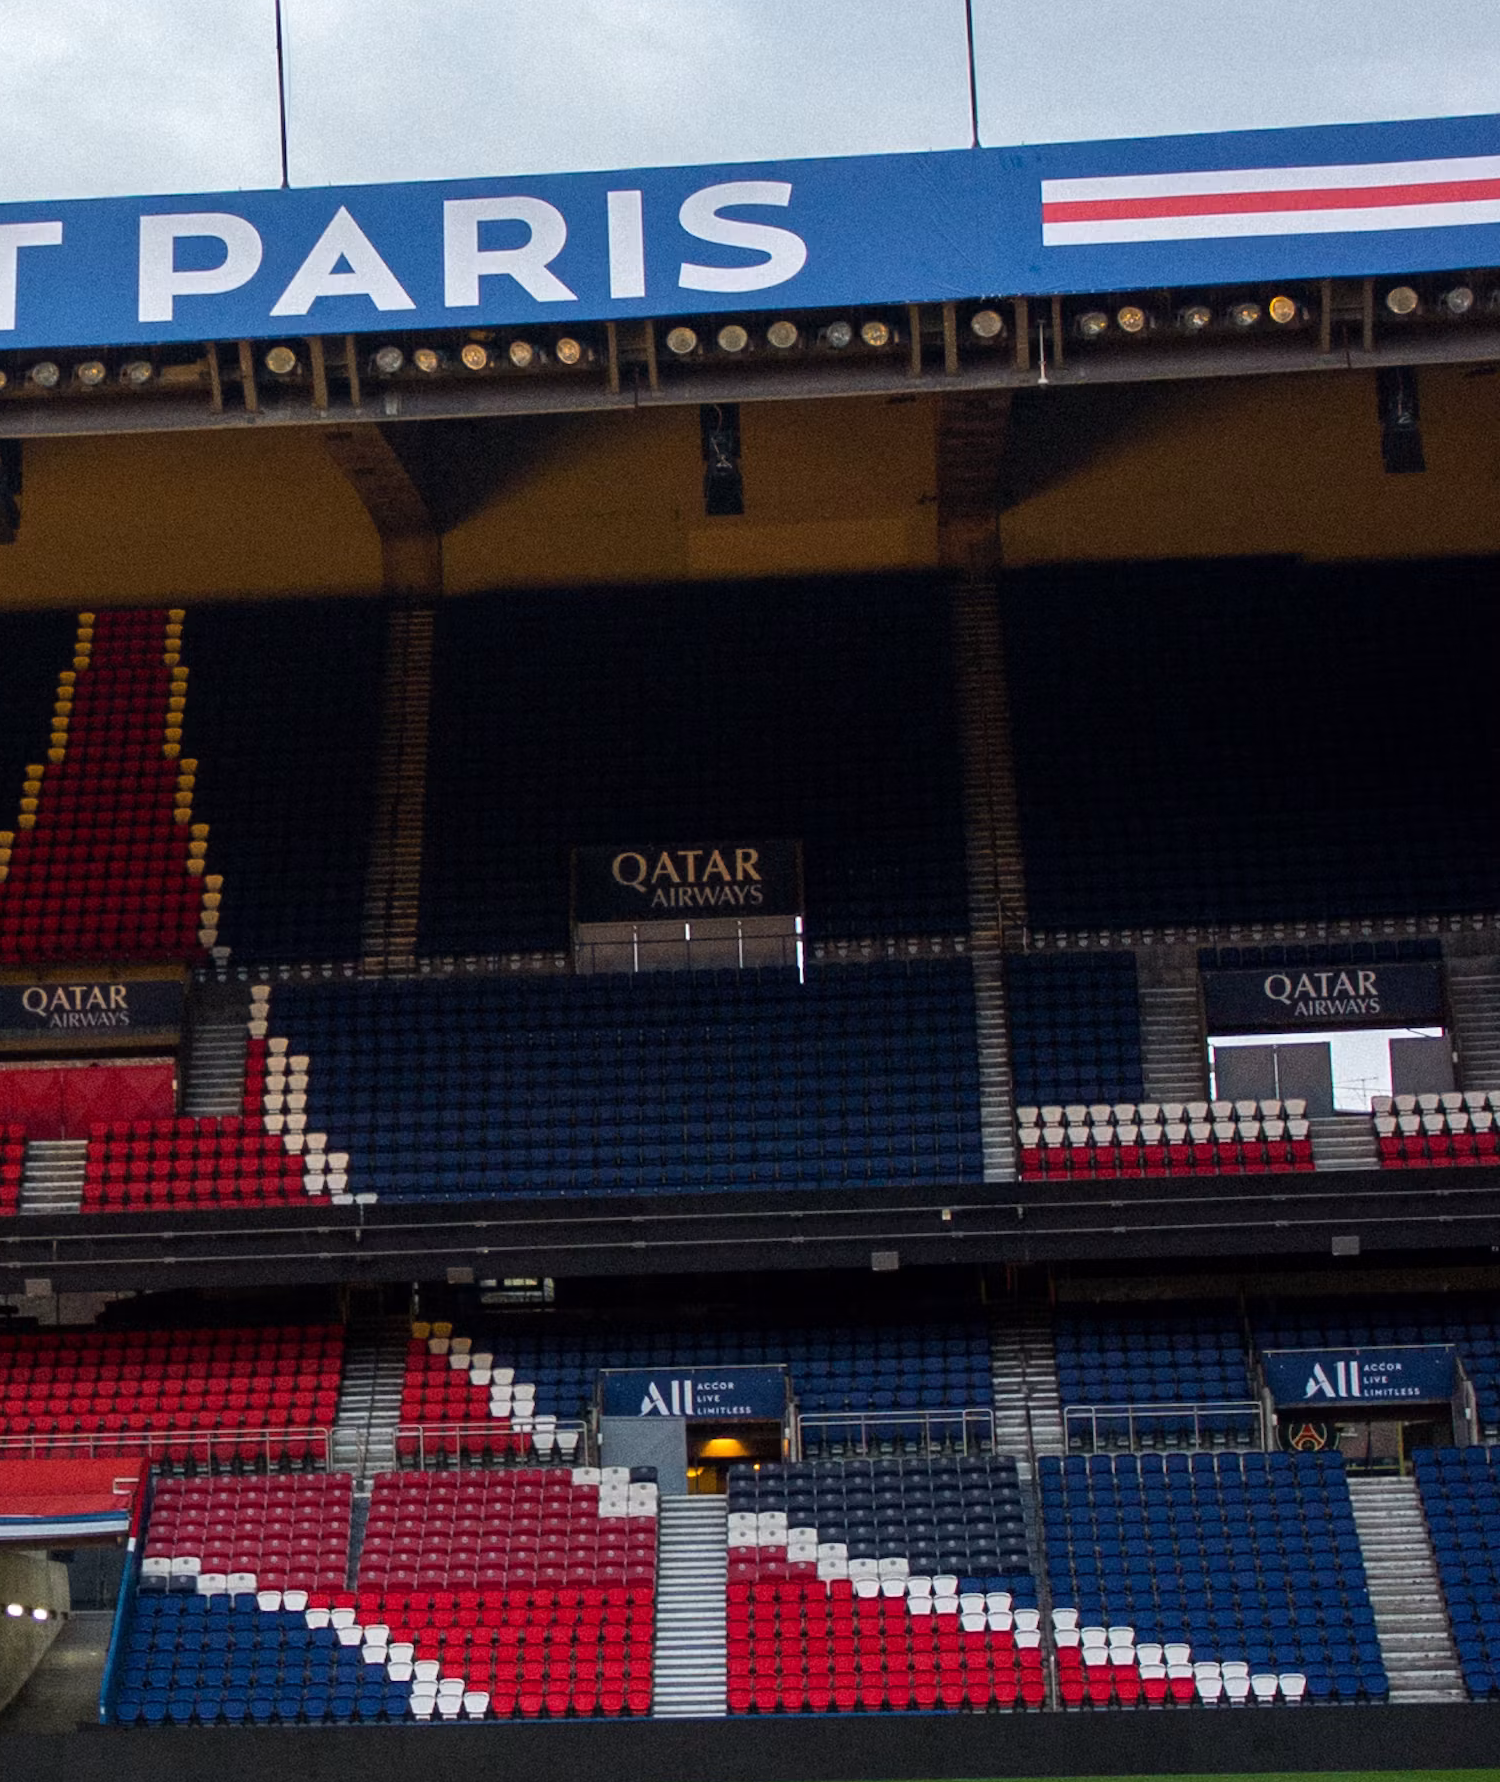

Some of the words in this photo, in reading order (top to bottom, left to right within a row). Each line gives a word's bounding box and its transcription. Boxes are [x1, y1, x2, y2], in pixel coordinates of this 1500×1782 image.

[139, 181, 807, 323] PARIS
[612, 848, 762, 893] QATAR
[652, 885, 763, 907] AIRWAYS
[1264, 970, 1378, 1005] QATAR
[22, 984, 128, 1017] QATAR
[1295, 998, 1380, 1015] AIRWAYS
[49, 1010, 130, 1028] AIRWAYS
[1363, 1362, 1403, 1372] ACCOR
[697, 1381, 735, 1390] ACCOR
[1363, 1375, 1388, 1385] LIVE
[697, 1394, 720, 1403] LIVE
[1363, 1387, 1421, 1397] LIMITLESS
[697, 1406, 752, 1416] LIMITLESS
